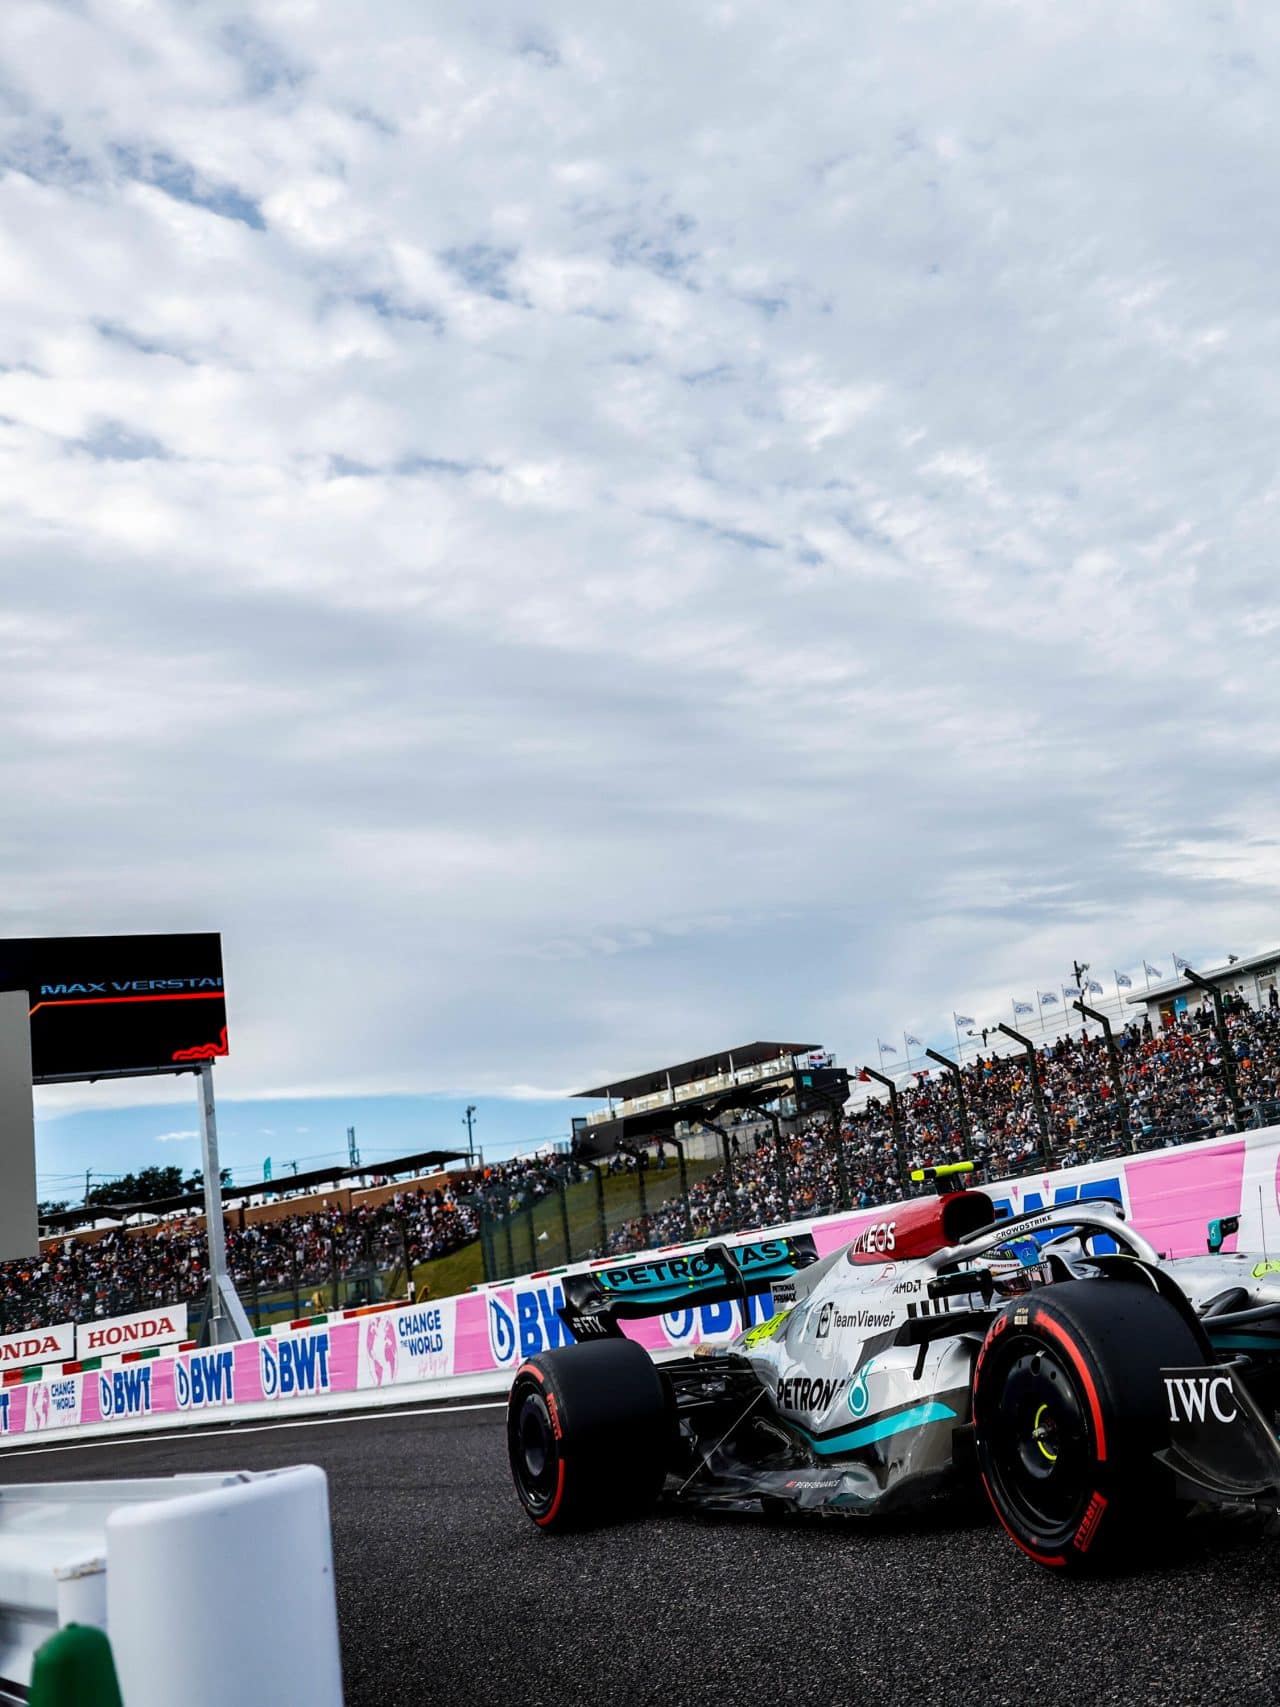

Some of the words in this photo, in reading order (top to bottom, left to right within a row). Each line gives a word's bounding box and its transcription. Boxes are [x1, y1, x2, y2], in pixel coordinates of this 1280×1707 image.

[41, 982, 107, 995] MAX
[852, 1222, 897, 1255] INEOS
[995, 1214, 1053, 1240] CROWDSTRIKE
[893, 1282, 913, 1294] AMD
[398, 1309, 442, 1337] CHANGE
[582, 1316, 607, 1334] FTX
[833, 1310, 896, 1328] TeamViewer
[87, 1317, 176, 1349] HONDA
[408, 1333, 443, 1356] WORLD
[0, 1335, 62, 1361] NDA
[278, 1334, 329, 1393] BWT
[51, 1380, 75, 1397] CHANGE
[113, 1366, 151, 1414] BWT
[191, 1352, 233, 1404] BWT
[1164, 1376, 1237, 1423] IWC
